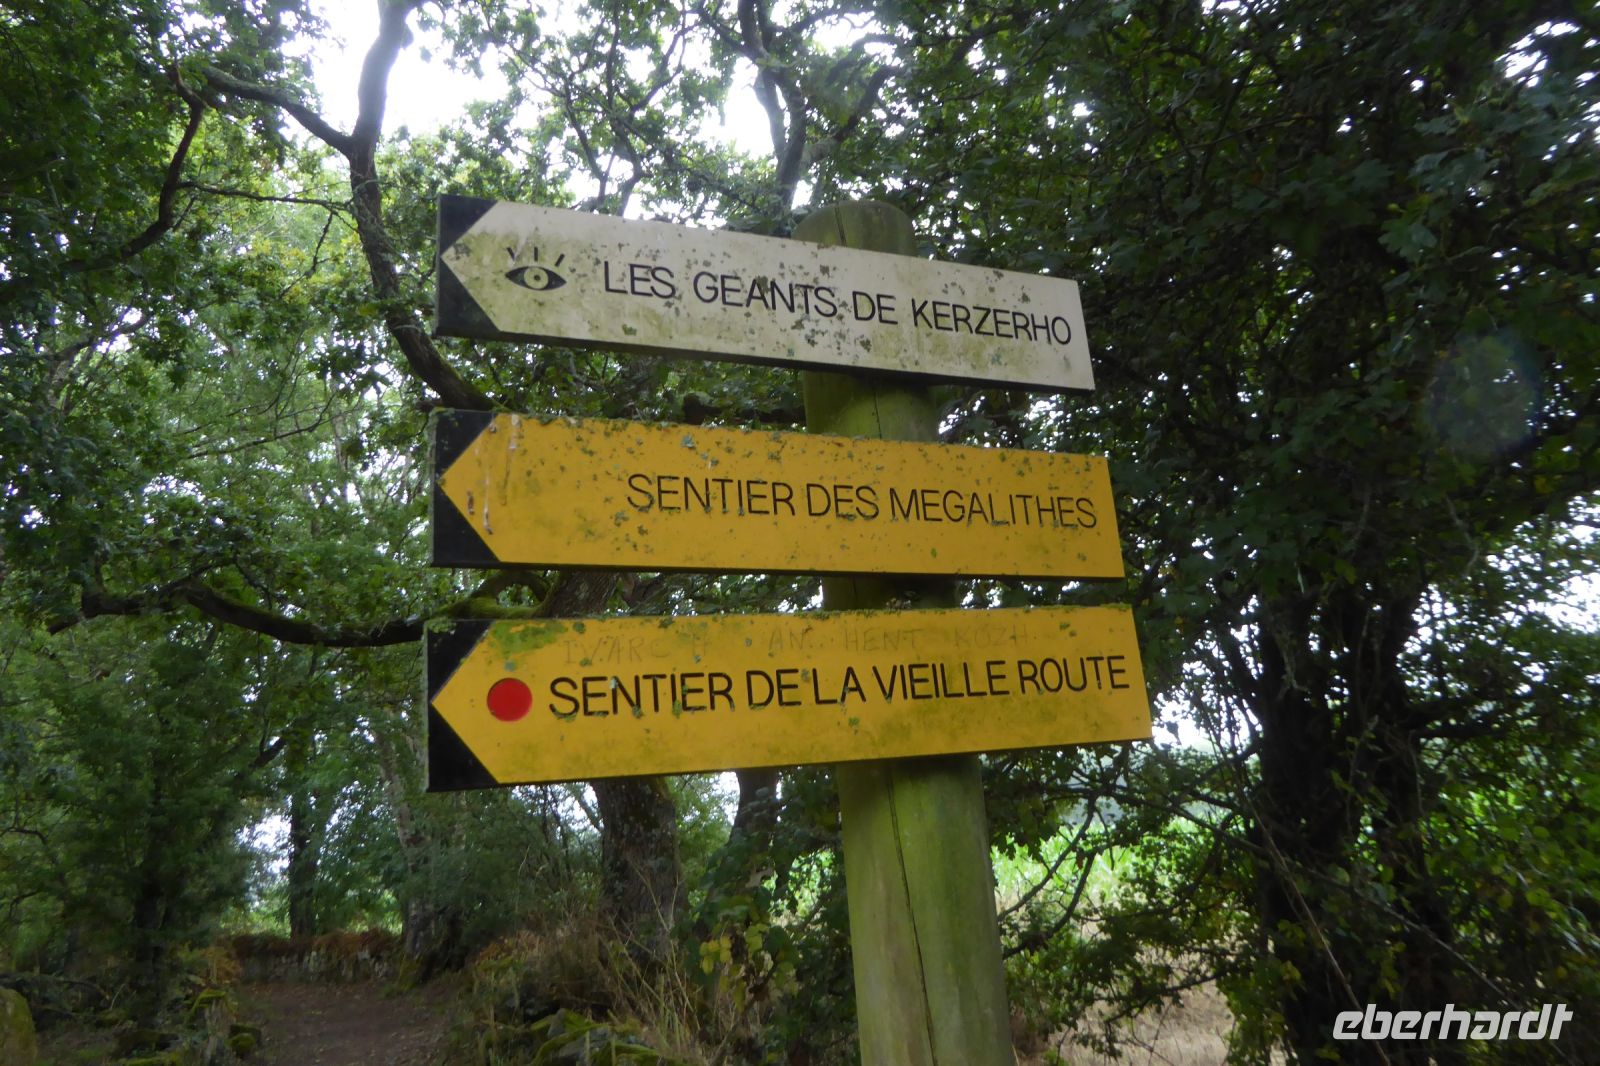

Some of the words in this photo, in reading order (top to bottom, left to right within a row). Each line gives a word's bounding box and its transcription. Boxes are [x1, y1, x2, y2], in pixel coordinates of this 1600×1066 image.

[603, 260, 677, 300] LES
[693, 270, 838, 318] GEANTS
[851, 290, 899, 325] DE
[911, 297, 1072, 346] KERZERHO
[626, 473, 796, 516] SENTIER
[806, 483, 880, 519] DES
[889, 487, 1097, 528] MEGALITHES
[548, 671, 736, 721] SENTIER
[745, 668, 802, 710] DE
[812, 666, 867, 705] LA
[872, 659, 1011, 701] VIEILLE
[1017, 655, 1131, 695] ROUTE
